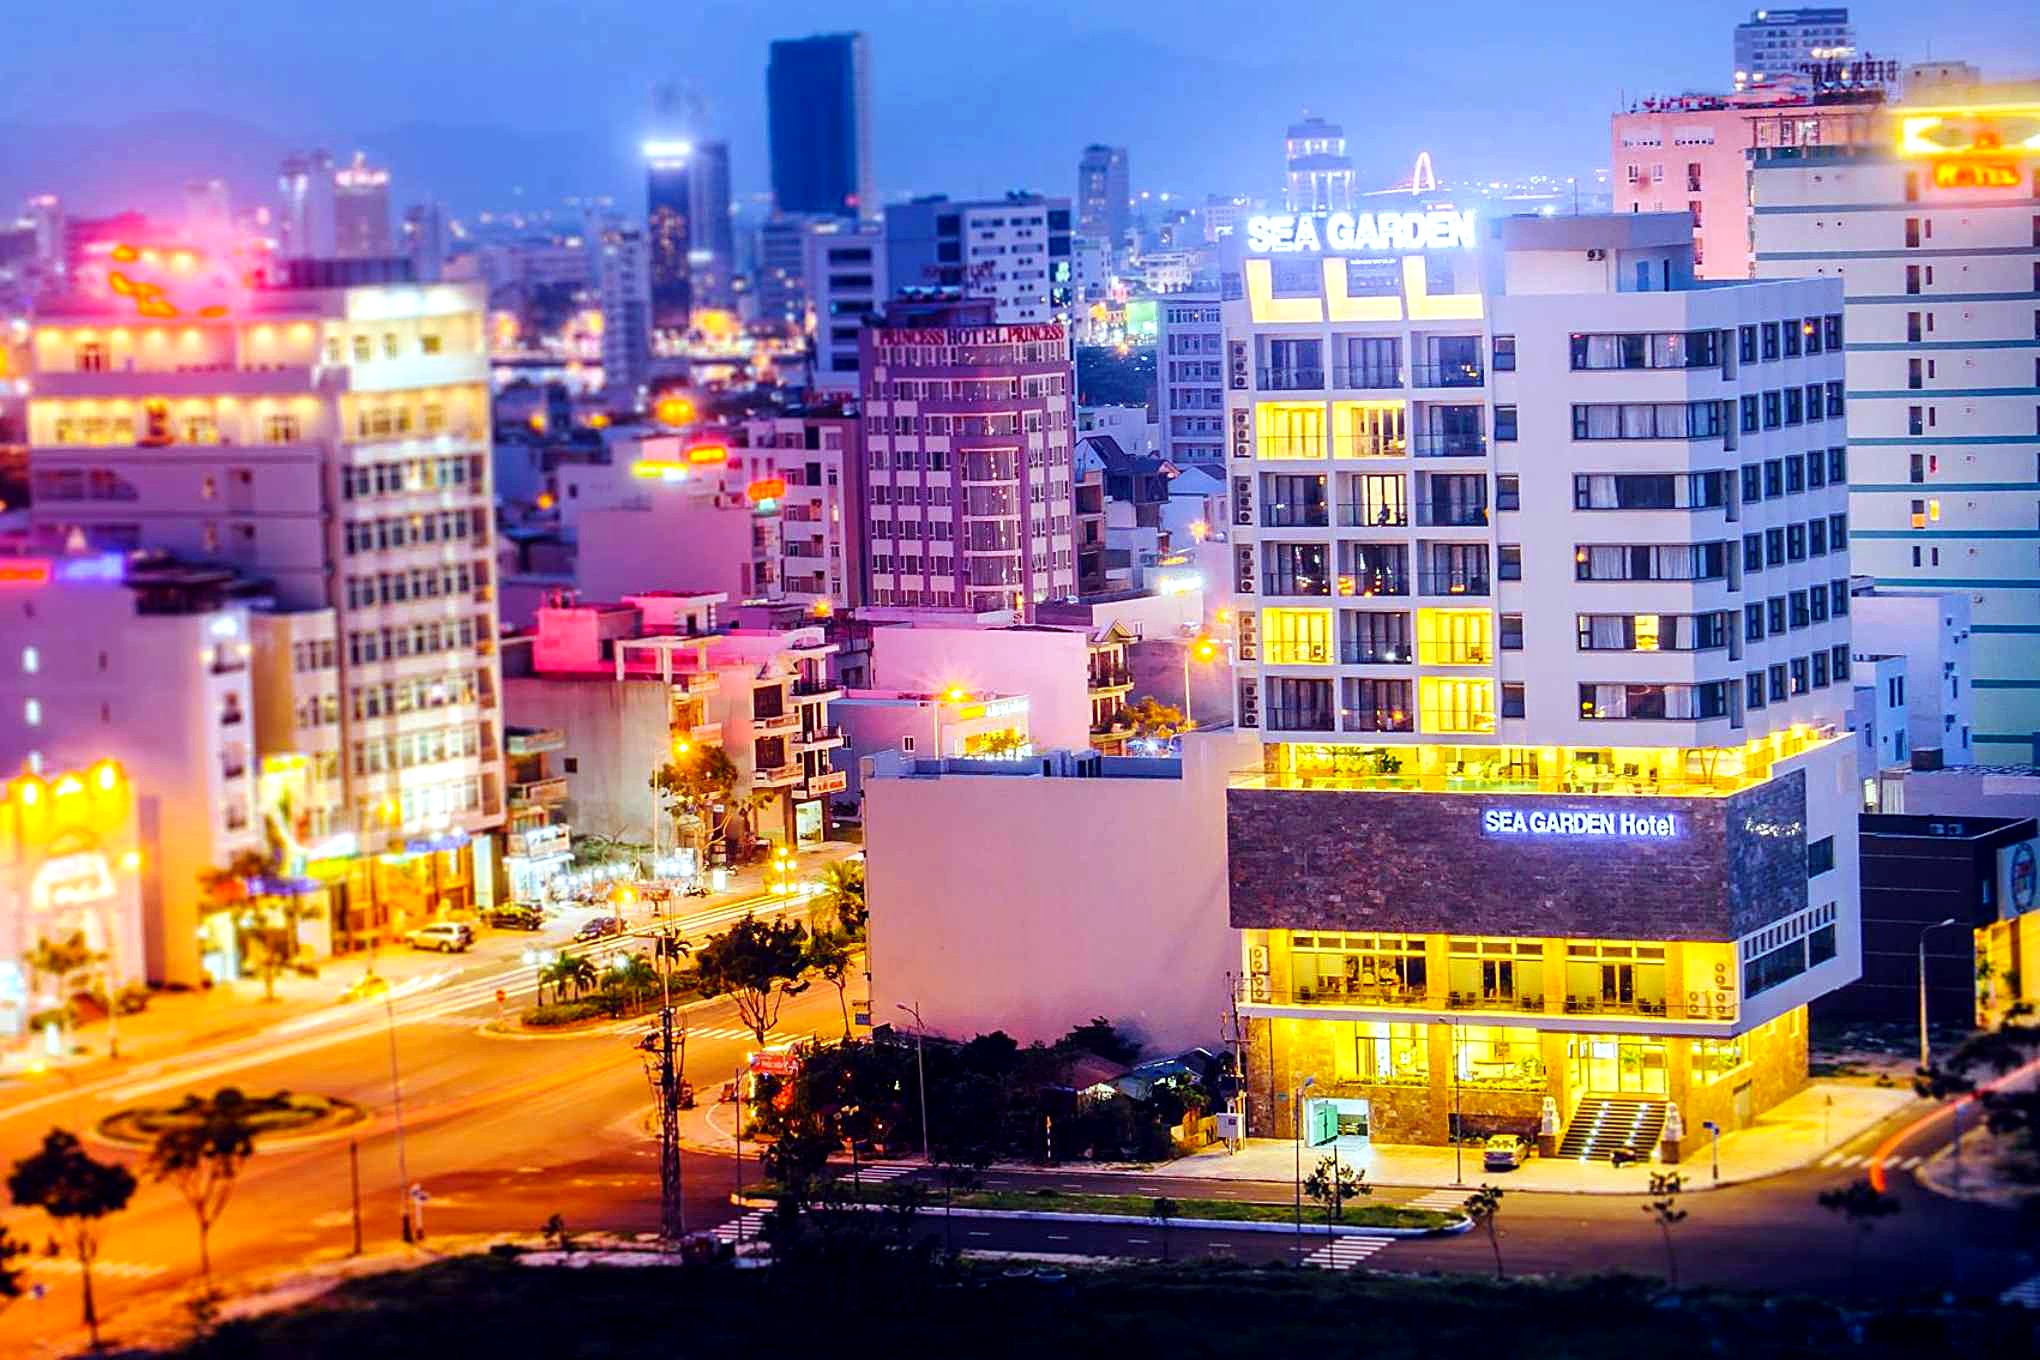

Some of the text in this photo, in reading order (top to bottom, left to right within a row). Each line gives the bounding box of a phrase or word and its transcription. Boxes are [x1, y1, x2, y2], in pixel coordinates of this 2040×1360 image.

[1247, 210, 1476, 252] SEA GARDEN
[879, 323, 1064, 346] PRINCESS HOTEL PRINCESS
[1485, 810, 1675, 836] SEA GARDEN Hotel
